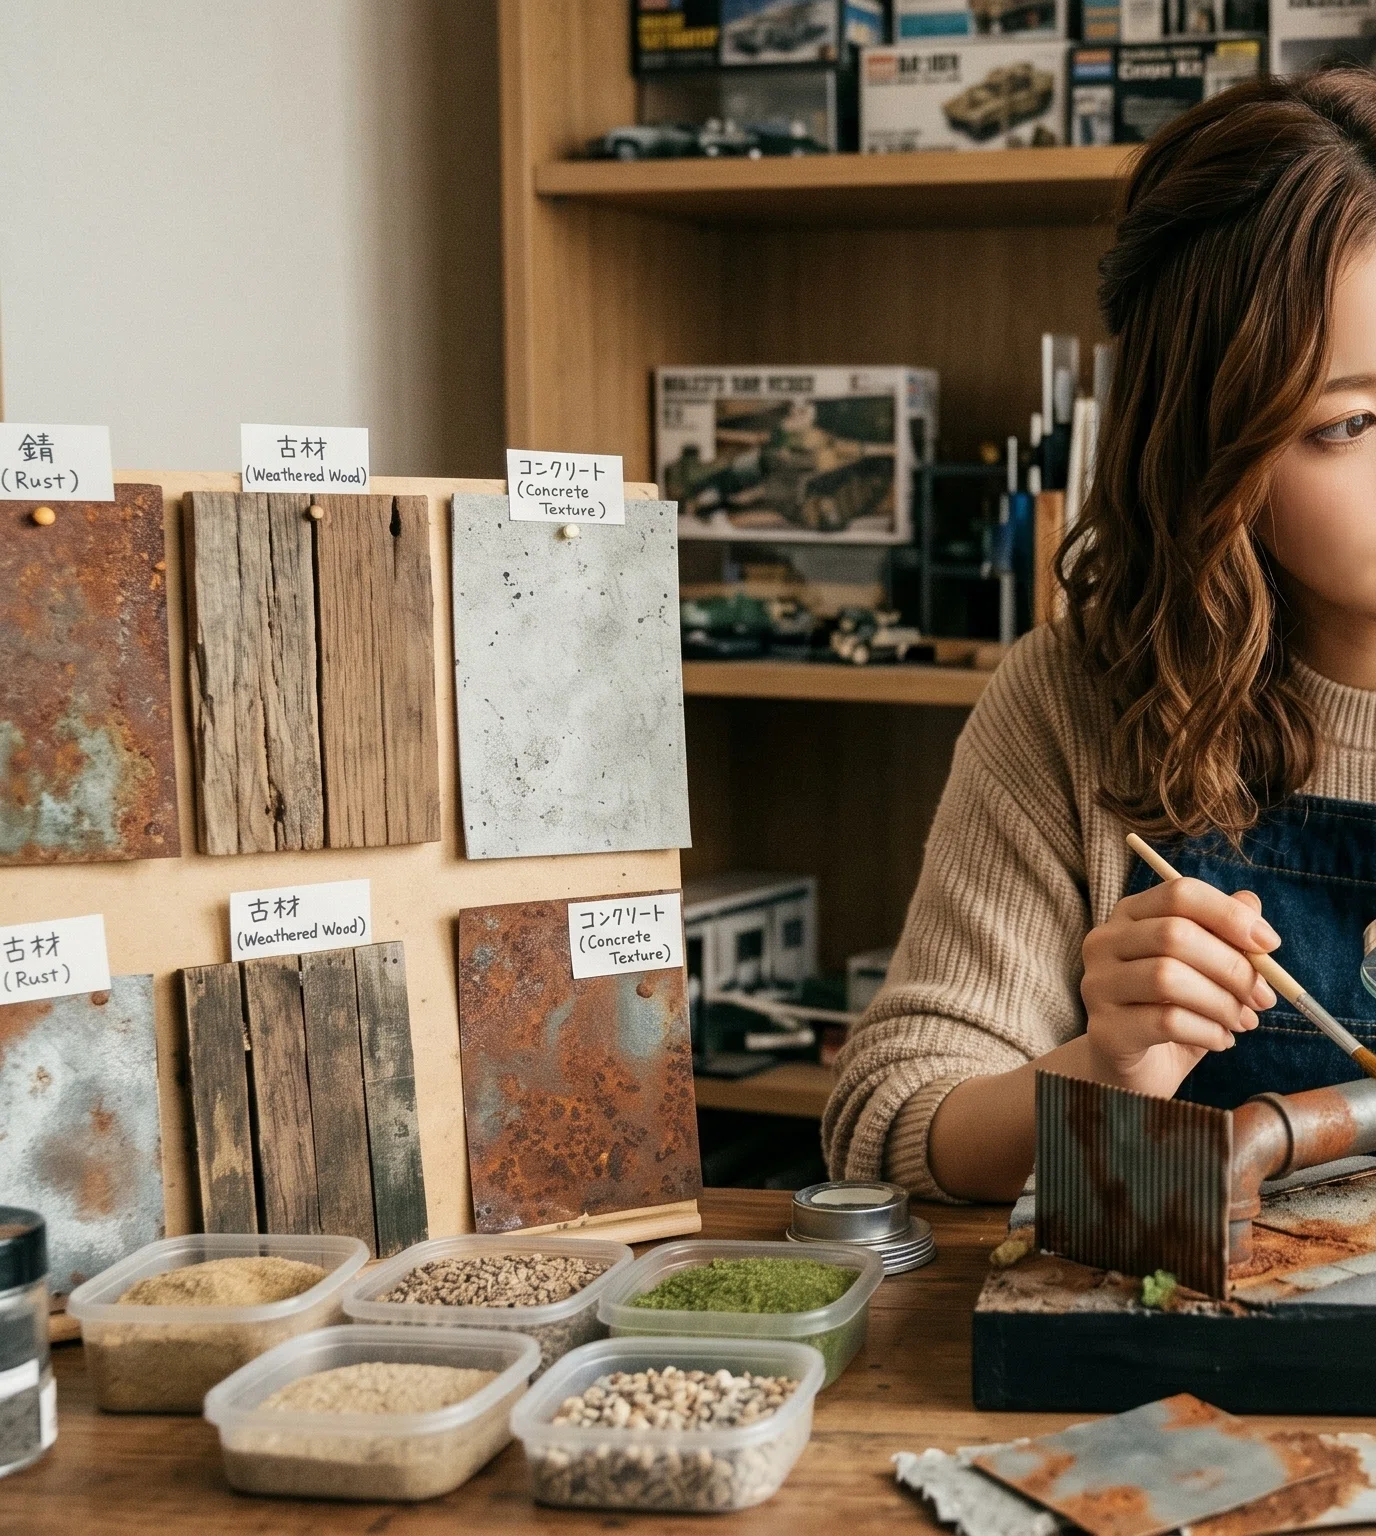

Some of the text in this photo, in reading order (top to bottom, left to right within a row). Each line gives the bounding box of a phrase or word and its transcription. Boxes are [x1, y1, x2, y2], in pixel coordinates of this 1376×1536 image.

[18, 433, 54, 463] 錆
[277, 435, 328, 460] 古材
[1, 468, 79, 493] (Rust)
[246, 465, 370, 487] (Weathered Wood)
[519, 460, 606, 481] コンクリート
[517, 481, 589, 499] (Concrete
[538, 501, 606, 519] Texture)
[248, 895, 301, 922] 古材
[580, 904, 665, 930] コンクリート
[237, 916, 366, 950] (Weathered Wood)
[579, 930, 651, 954] (Concrete
[3, 932, 60, 963] 古材
[609, 943, 671, 965] Texture)
[3, 964, 70, 992] (Rust)
